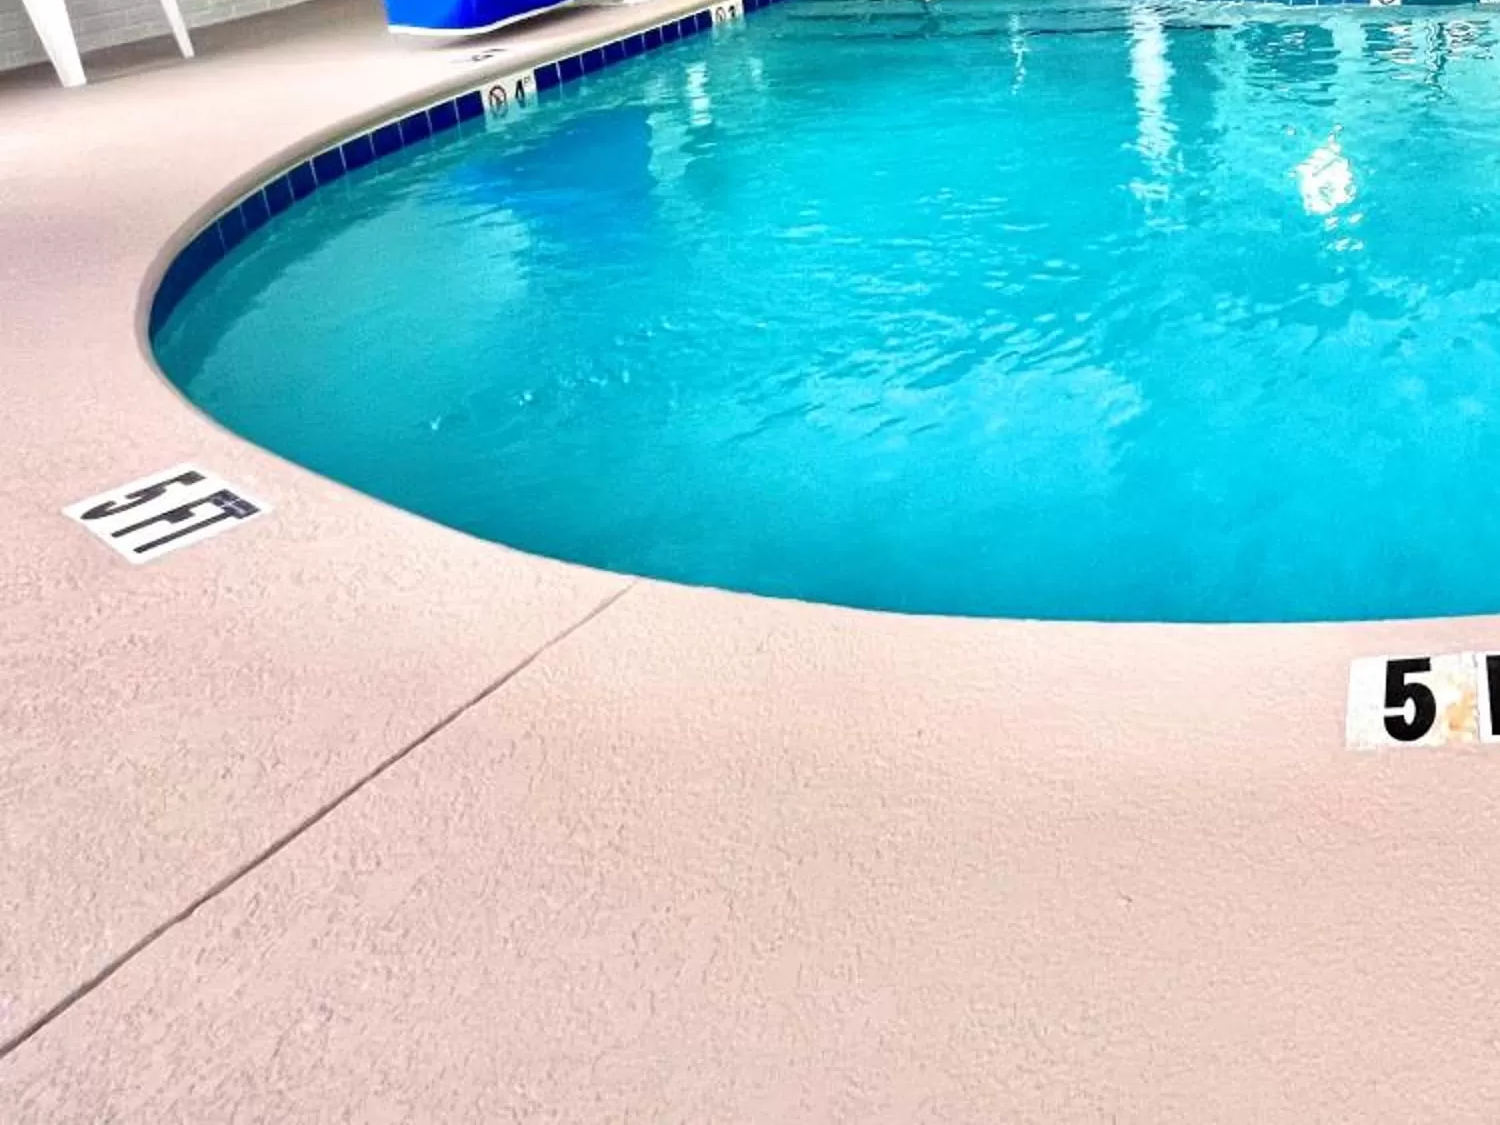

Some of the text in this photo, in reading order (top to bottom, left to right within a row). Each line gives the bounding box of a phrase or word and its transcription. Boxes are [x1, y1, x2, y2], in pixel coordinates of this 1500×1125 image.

[81, 470, 262, 554] 5 FT
[1383, 656, 1437, 742] 5
